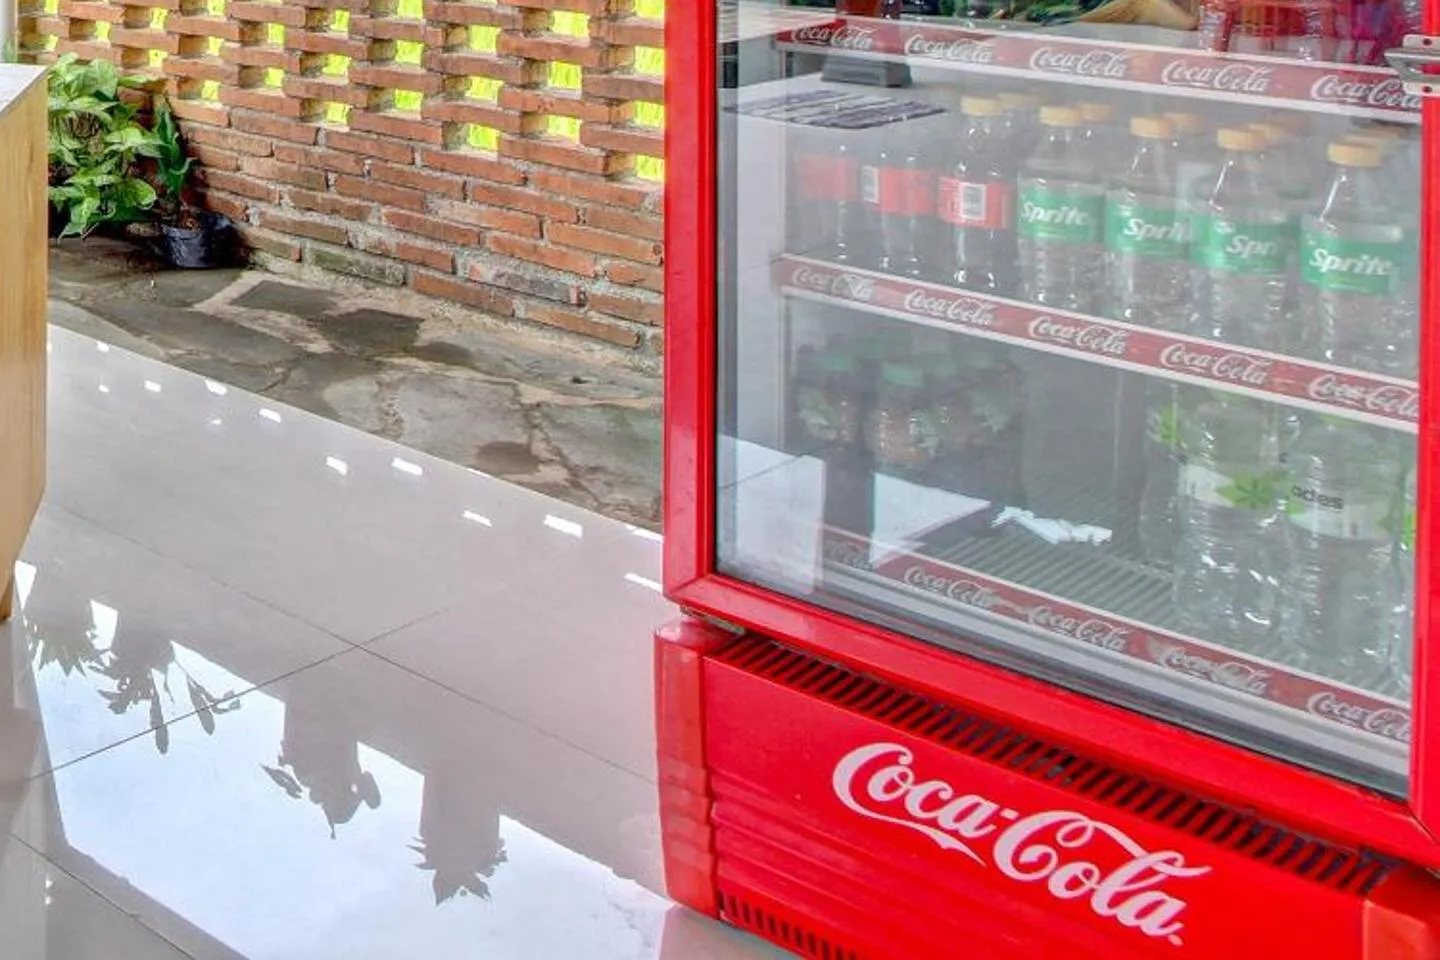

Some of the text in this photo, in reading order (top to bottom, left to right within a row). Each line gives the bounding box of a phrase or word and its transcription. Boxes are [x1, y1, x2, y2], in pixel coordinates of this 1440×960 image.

[1161, 59, 1277, 92] Coca-Cola
[1020, 201, 1090, 226] Sprite
[1309, 248, 1396, 276] Sprite
[1161, 342, 1271, 386] Coca-Cola
[832, 742, 1212, 944] Coca-Cola
